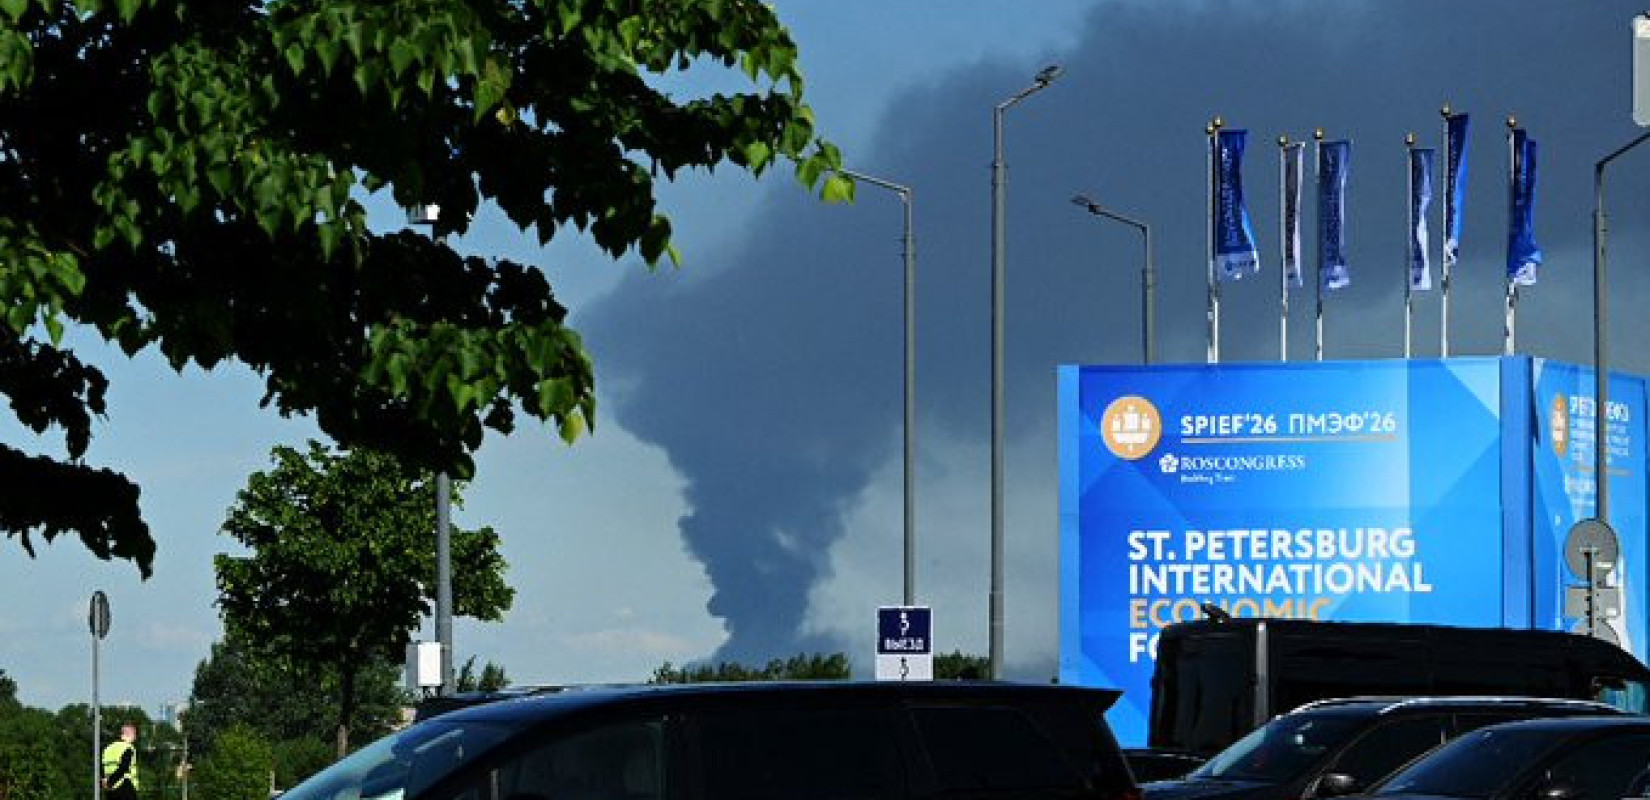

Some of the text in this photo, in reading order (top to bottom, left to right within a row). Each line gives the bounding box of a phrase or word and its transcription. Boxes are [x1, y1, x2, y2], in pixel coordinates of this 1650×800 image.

[1181, 411, 1396, 435] SPIEF'26 ПМЭФ'26
[1181, 455, 1306, 470] ROSCONGRESS
[1128, 528, 1415, 561] ST. PETERSBURG
[1130, 562, 1432, 594] INTERNATIONAL
